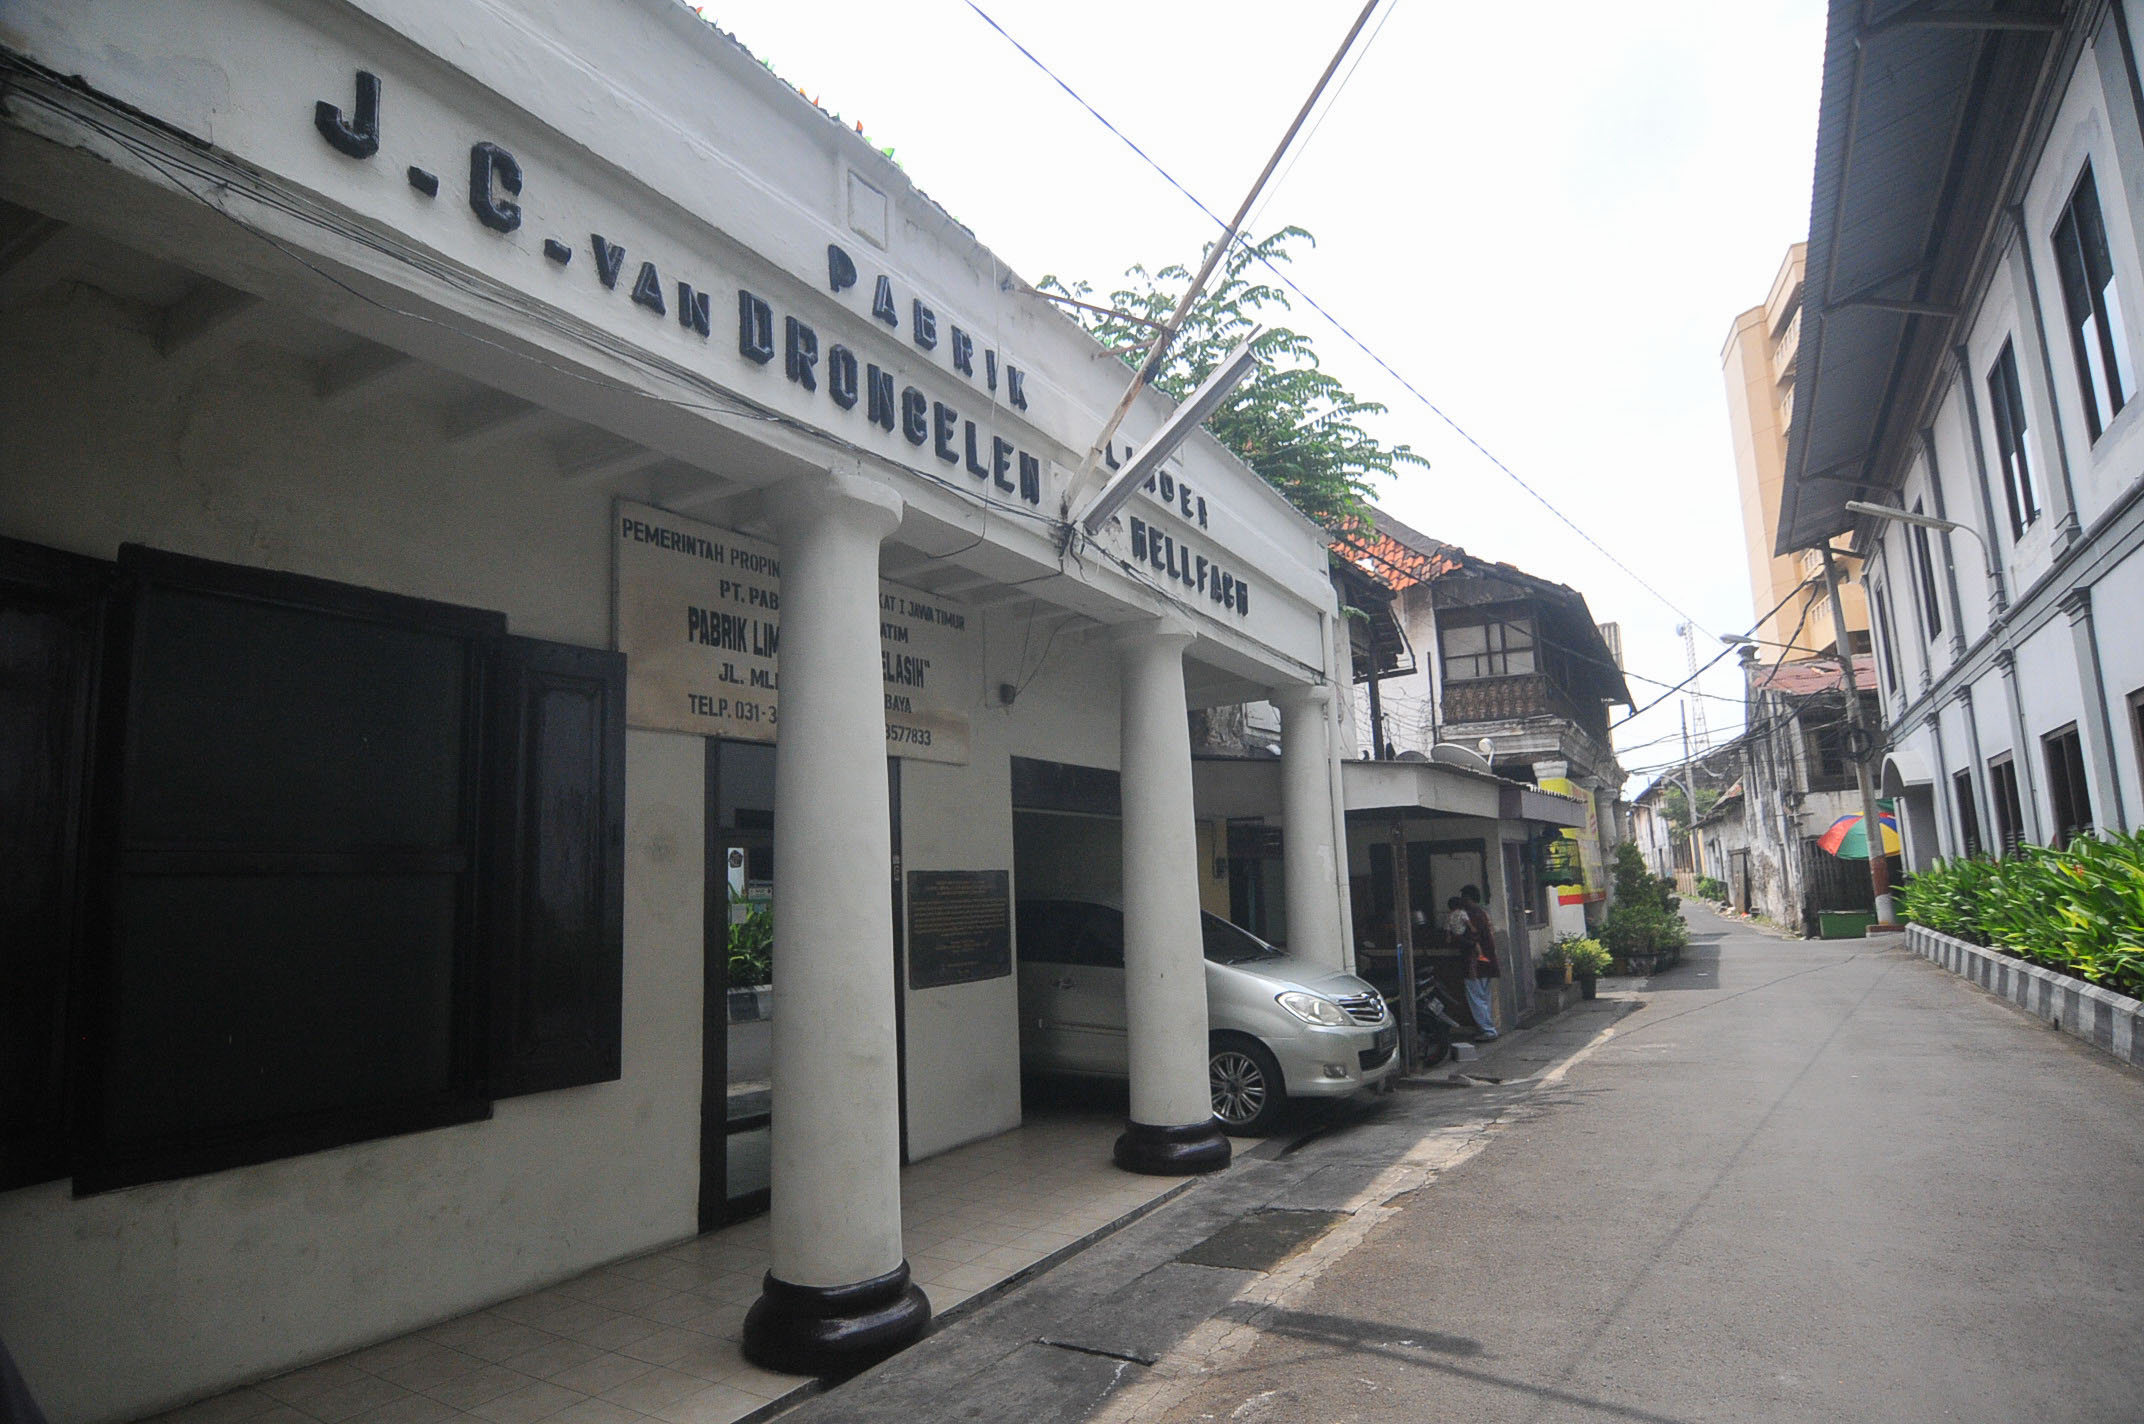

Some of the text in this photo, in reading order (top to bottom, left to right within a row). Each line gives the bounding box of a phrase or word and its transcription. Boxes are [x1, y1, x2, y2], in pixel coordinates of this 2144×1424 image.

[828, 244, 1028, 412] PABRIK
[591, 233, 710, 338] VAN
[738, 289, 1040, 505] DRONGELEN
[622, 517, 724, 563] PEMERINTAH
[908, 601, 934, 622] JAWA
[935, 607, 965, 632] TIMUR
[720, 579, 745, 603] PT.
[750, 587, 779, 610] PAB
[687, 606, 748, 653] PABRIK
[718, 663, 745, 685] JL.
[688, 693, 732, 718] TELP.
